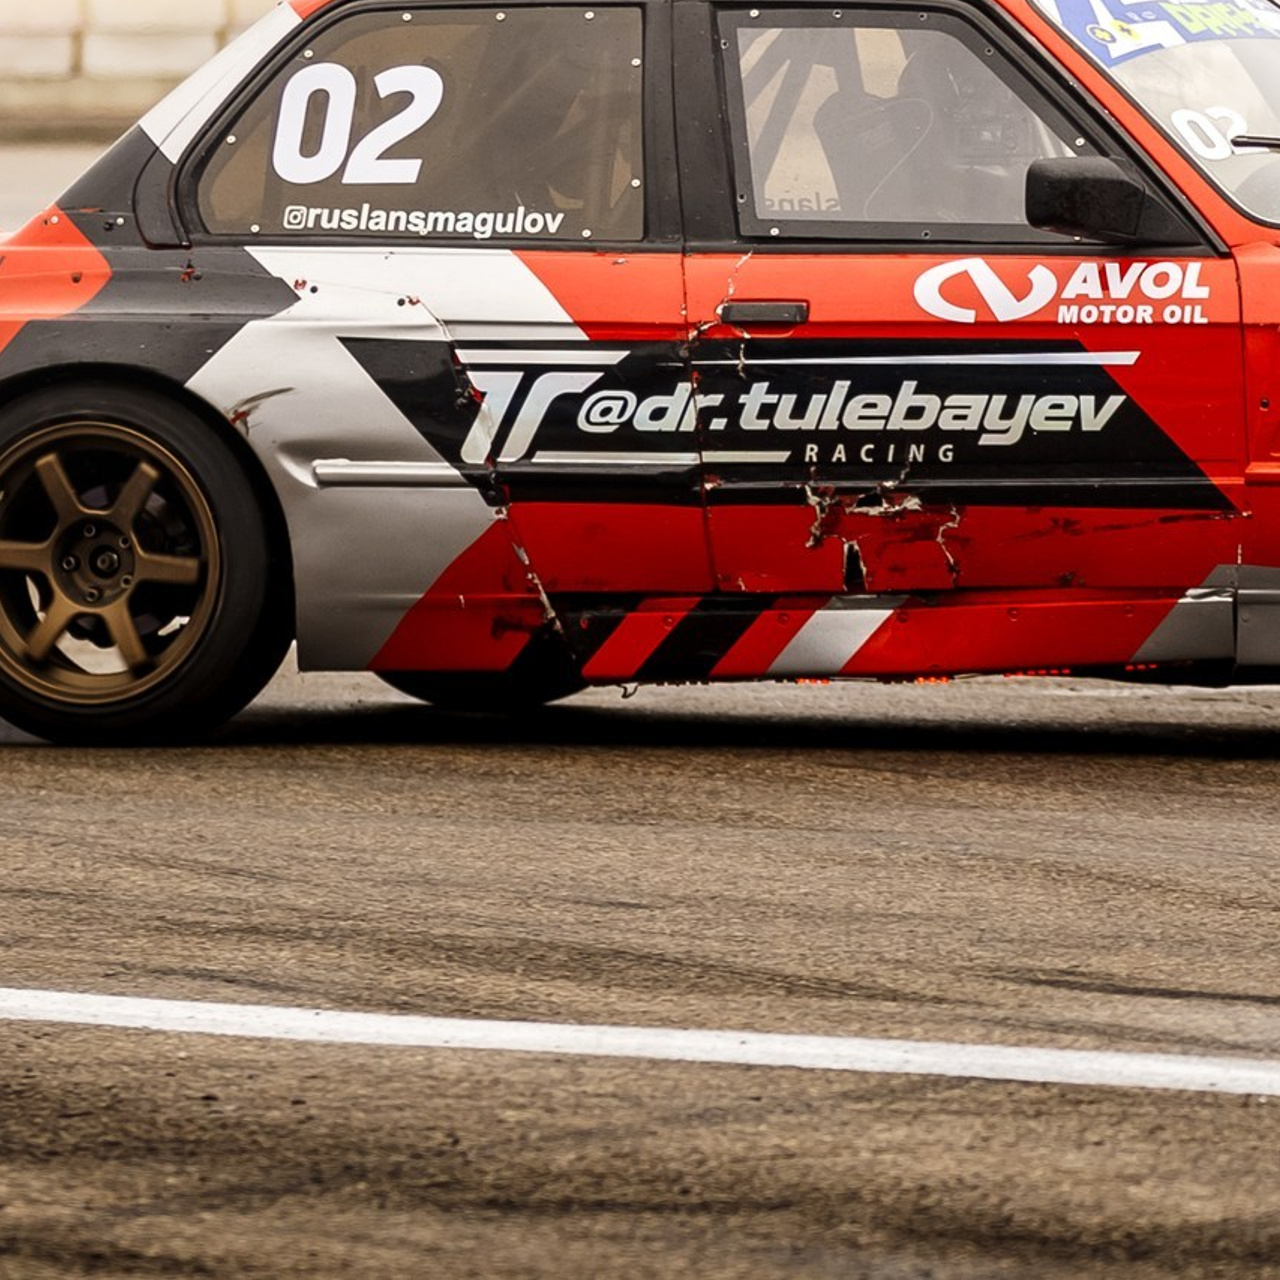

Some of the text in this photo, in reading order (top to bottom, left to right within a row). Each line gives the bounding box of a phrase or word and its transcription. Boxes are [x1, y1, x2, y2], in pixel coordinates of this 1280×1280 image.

[271, 62, 444, 184] 02
[1170, 106, 1271, 161] 02
[306, 203, 565, 239] ruslansmagulov
[1060, 261, 1210, 299] AVOL
[1057, 305, 1209, 324] MOTOR OIL
[576, 380, 1127, 446] @dr.tulebayev
[804, 443, 954, 463] RACING
